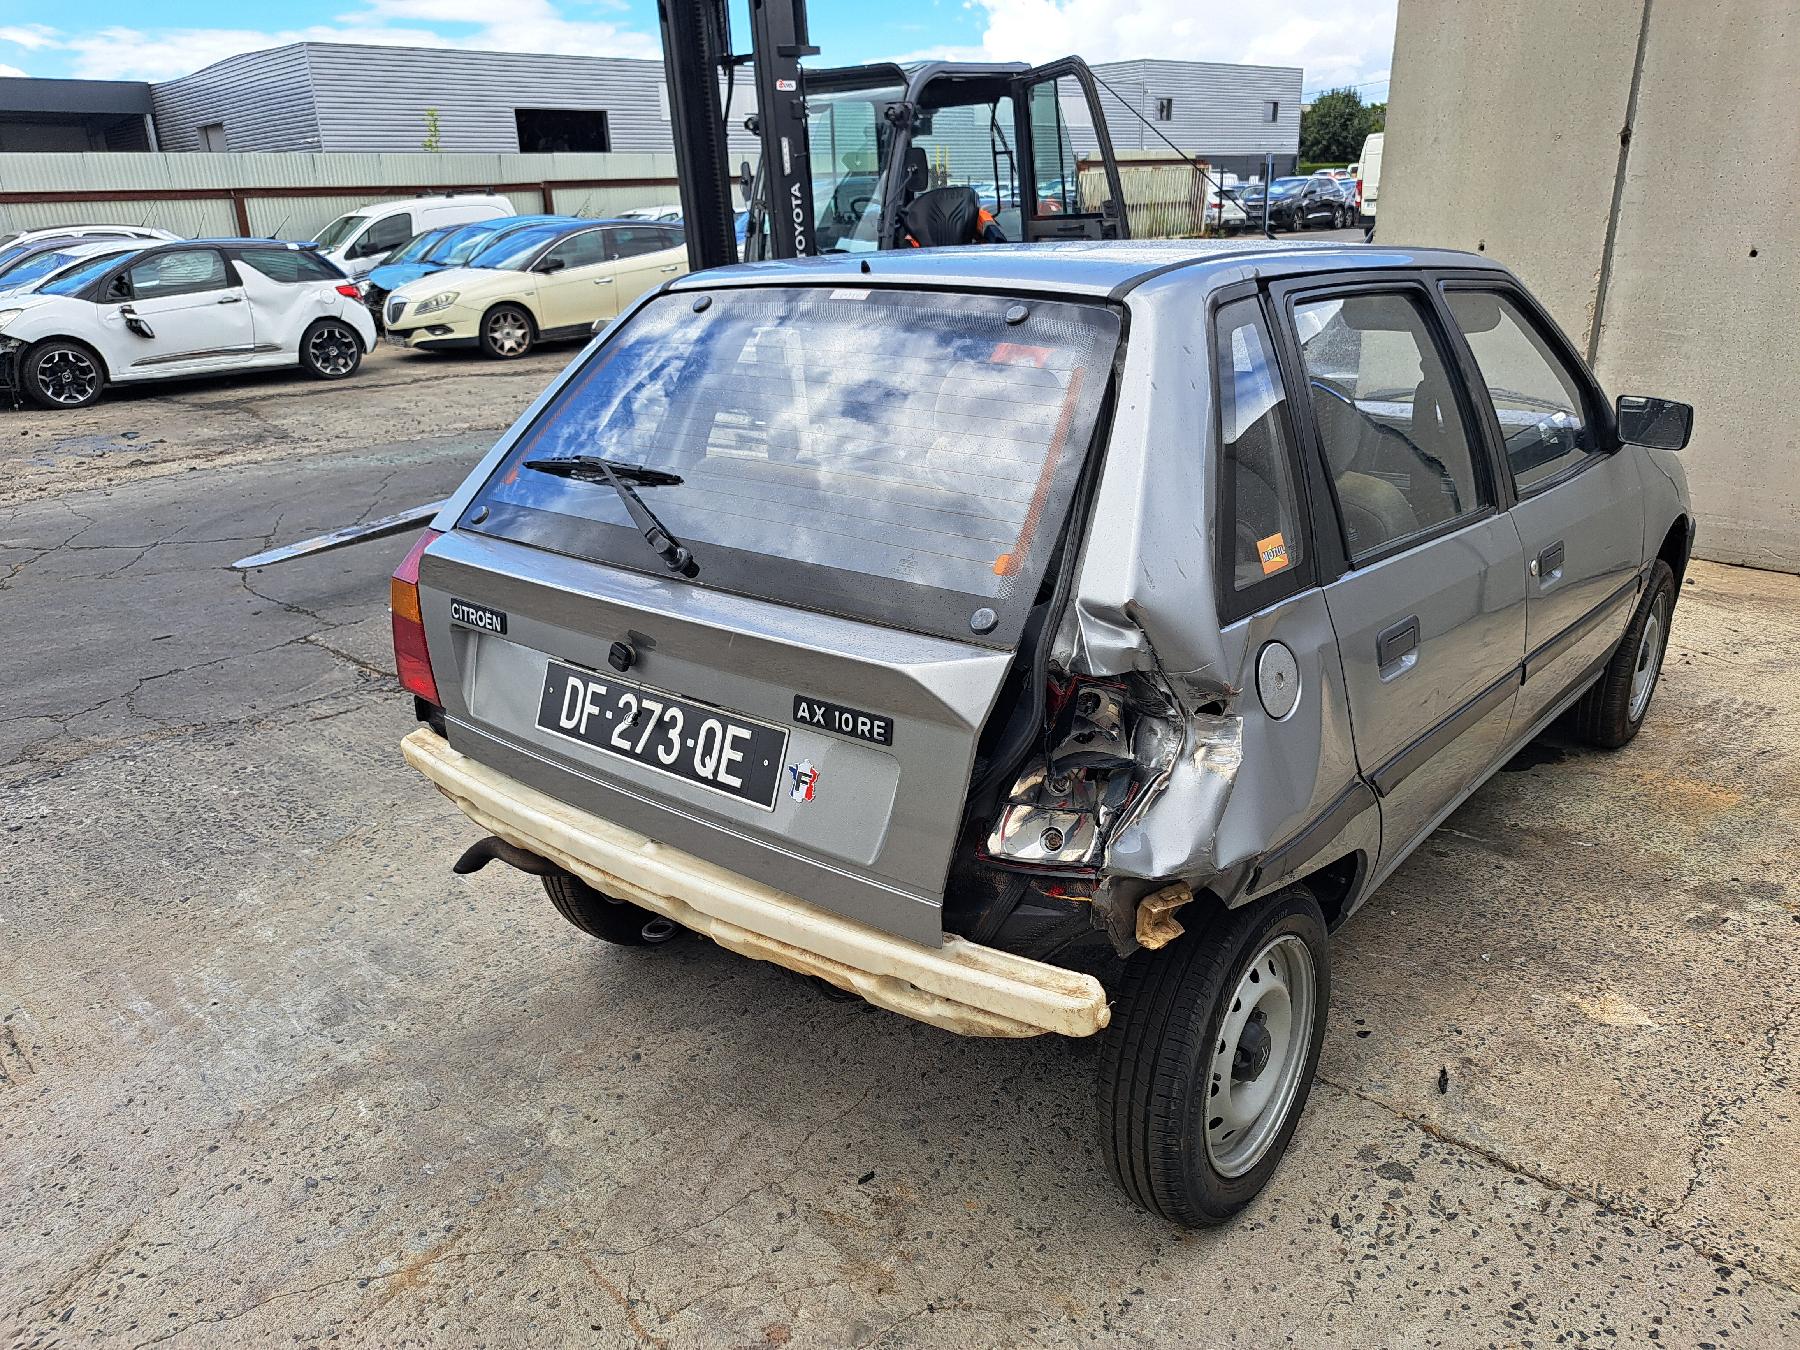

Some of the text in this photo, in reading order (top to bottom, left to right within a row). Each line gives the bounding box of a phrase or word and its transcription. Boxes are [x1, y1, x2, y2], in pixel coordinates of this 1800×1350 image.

[451, 603, 501, 632] CITROËN
[796, 701, 826, 727] AX
[794, 771, 813, 791] F
